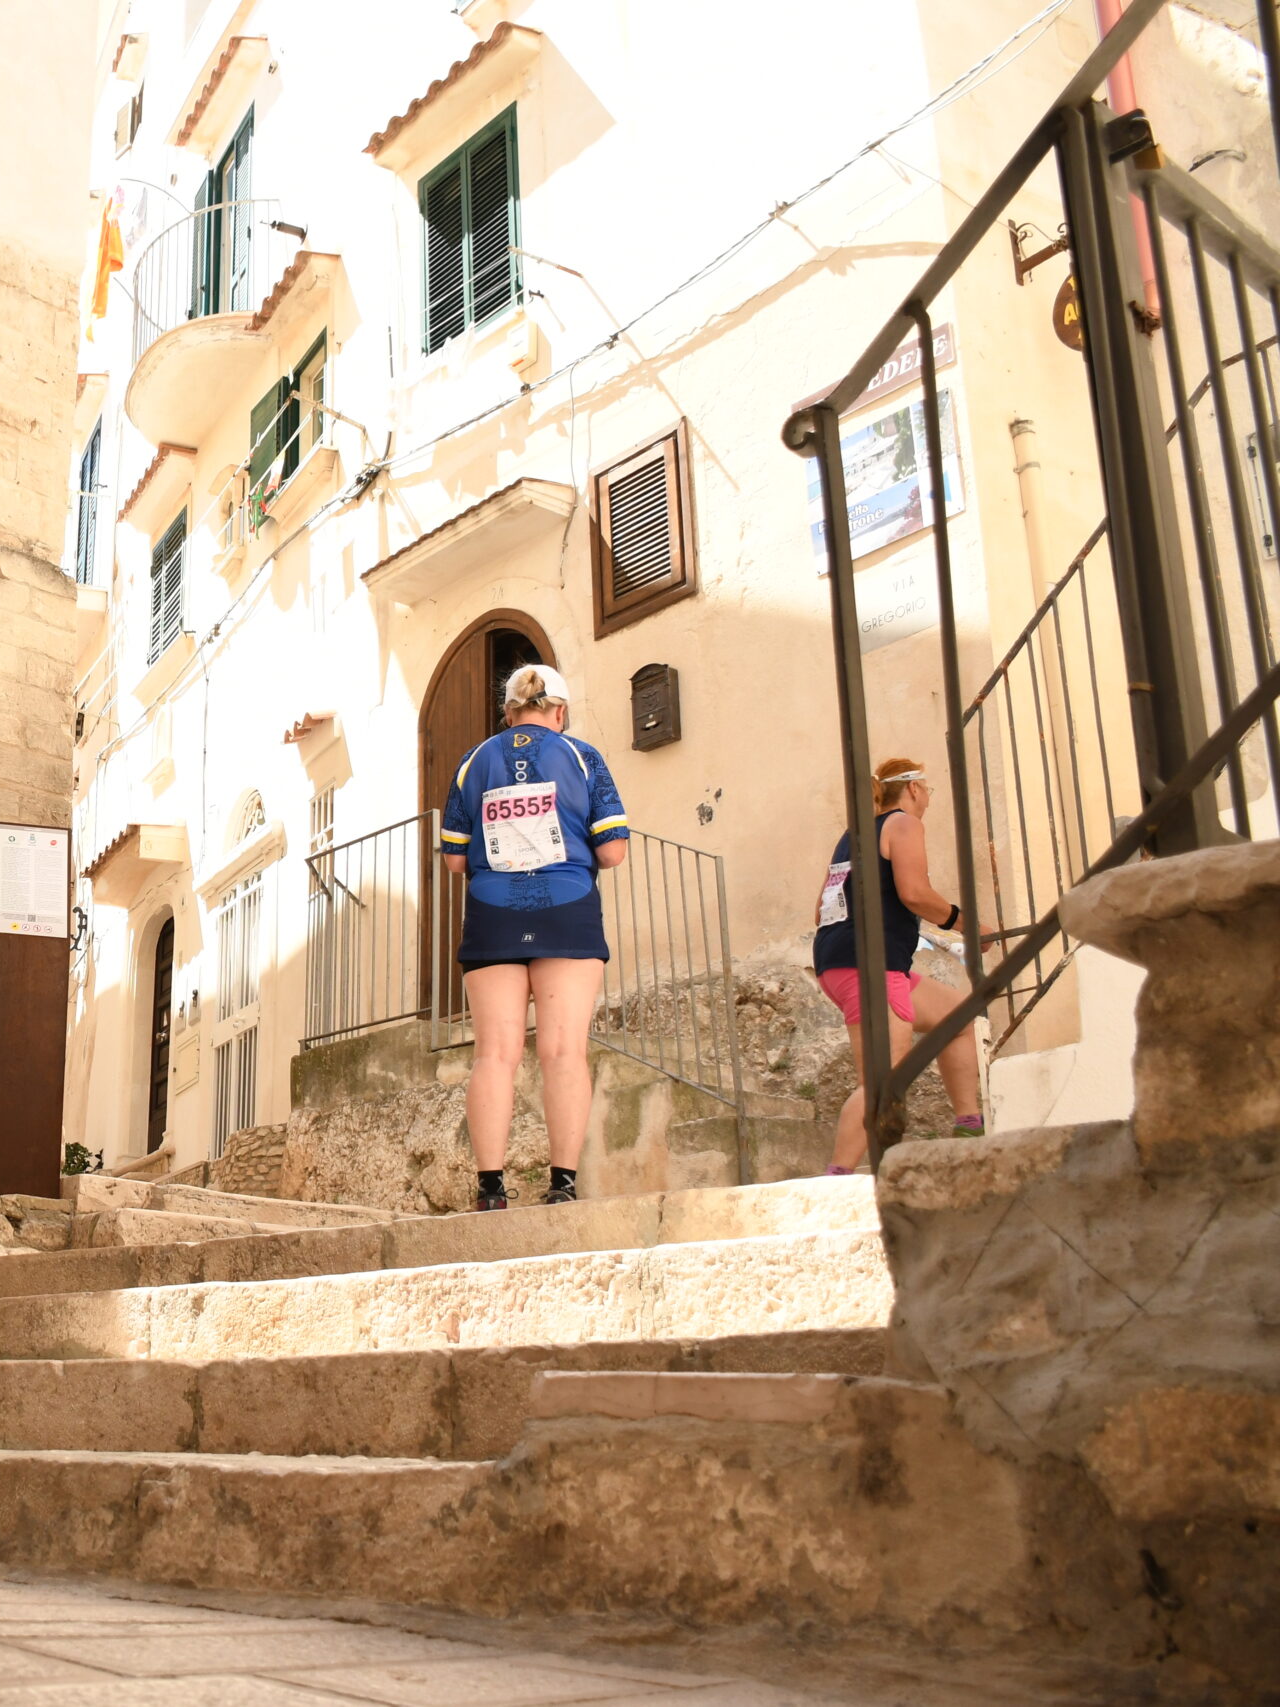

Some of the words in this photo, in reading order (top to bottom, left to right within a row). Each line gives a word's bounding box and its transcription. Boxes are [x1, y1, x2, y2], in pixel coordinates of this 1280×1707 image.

[893, 574, 915, 592] VIA
[861, 597, 926, 633] GREGORIO
[515, 761, 527, 785] DO
[486, 795, 553, 821] 65555
